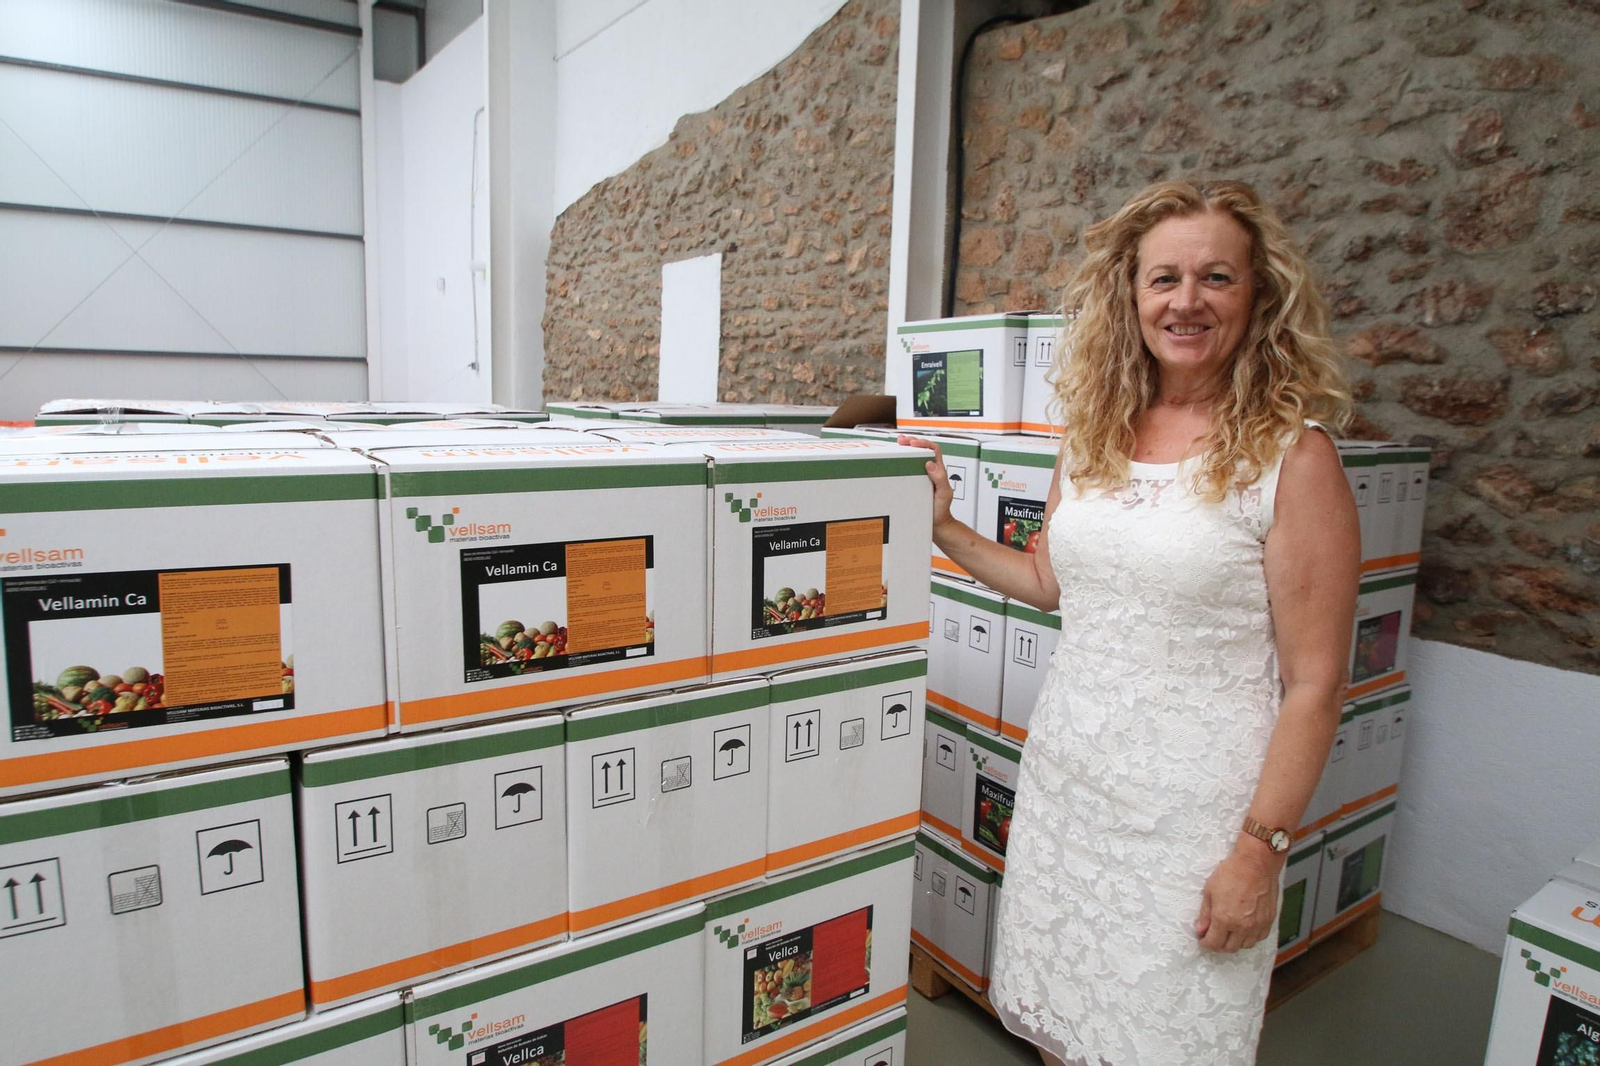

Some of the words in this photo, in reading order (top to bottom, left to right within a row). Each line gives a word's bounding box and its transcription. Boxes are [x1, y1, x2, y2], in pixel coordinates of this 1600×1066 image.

[754, 506, 797, 517] vellsam
[1004, 506, 1044, 520] Maxifruit
[449, 523, 511, 537] vellsam
[479, 533, 510, 541] bioactivas
[769, 538, 807, 551] Vellamin
[809, 537, 820, 547] Ca
[0, 564, 33, 572] aterias
[36, 560, 83, 570] bioactivas
[485, 562, 539, 577] Vellamin
[543, 560, 558, 572] Ca
[38, 594, 119, 612] Vellamin
[125, 593, 147, 606] Ca
[981, 785, 1014, 809] Maxifrui
[741, 921, 783, 940] vellsam
[768, 945, 799, 962] Vellca
[467, 1014, 526, 1040] vellsam
[467, 1034, 494, 1046] materias
[494, 1023, 524, 1037] bioactivas
[502, 1045, 545, 1066] Vellca
